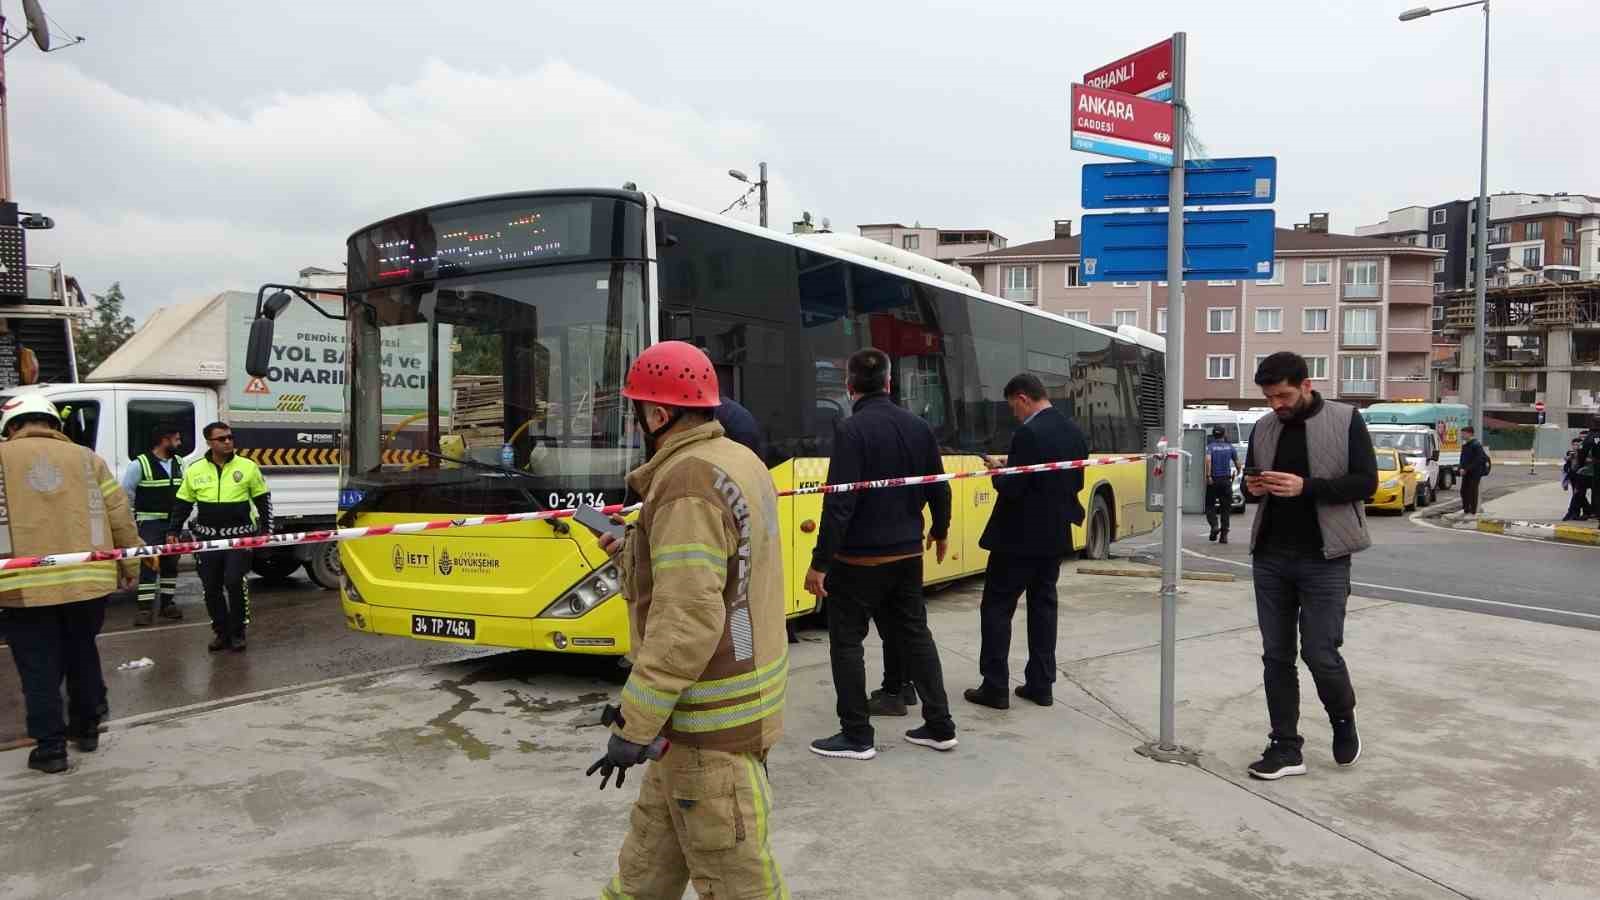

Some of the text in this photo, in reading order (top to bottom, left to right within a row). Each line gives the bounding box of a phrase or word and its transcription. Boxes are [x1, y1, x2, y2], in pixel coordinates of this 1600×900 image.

[1087, 62, 1135, 88] ORHANLI
[1079, 94, 1134, 120] ANKARA
[297, 332, 338, 343] PENDİK
[273, 345, 316, 362] YOL
[400, 357, 421, 369] ve
[266, 367, 343, 385] ONARI
[549, 492, 605, 509] 0-2134
[407, 551, 430, 566] İETT
[415, 617, 471, 637] 34 TP 7464
